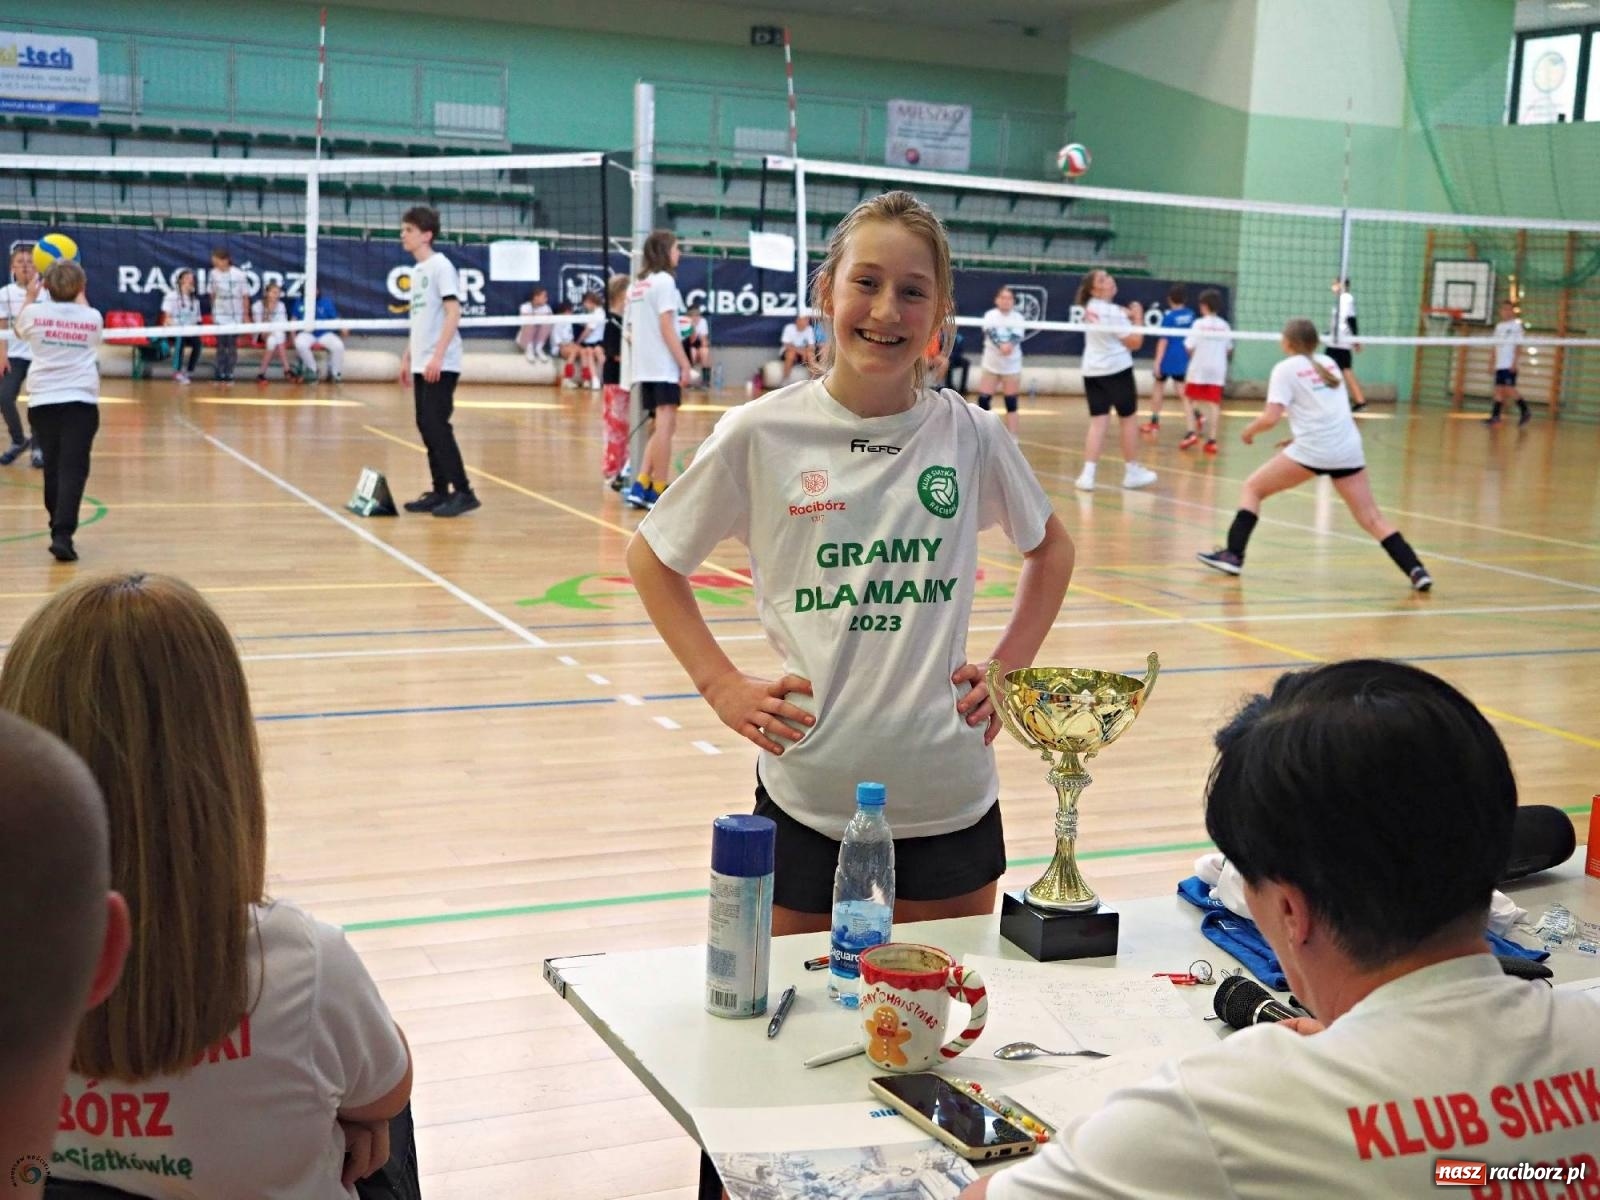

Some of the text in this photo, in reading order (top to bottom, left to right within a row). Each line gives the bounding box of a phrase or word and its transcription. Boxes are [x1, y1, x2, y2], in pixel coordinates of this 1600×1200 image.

[789, 500, 846, 516] Racibórz
[816, 538, 943, 568] GRAMY
[795, 577, 958, 613] DLA MAMY
[849, 615, 902, 632] 2023
[1346, 1067, 1600, 1160] KLUB SIATK
